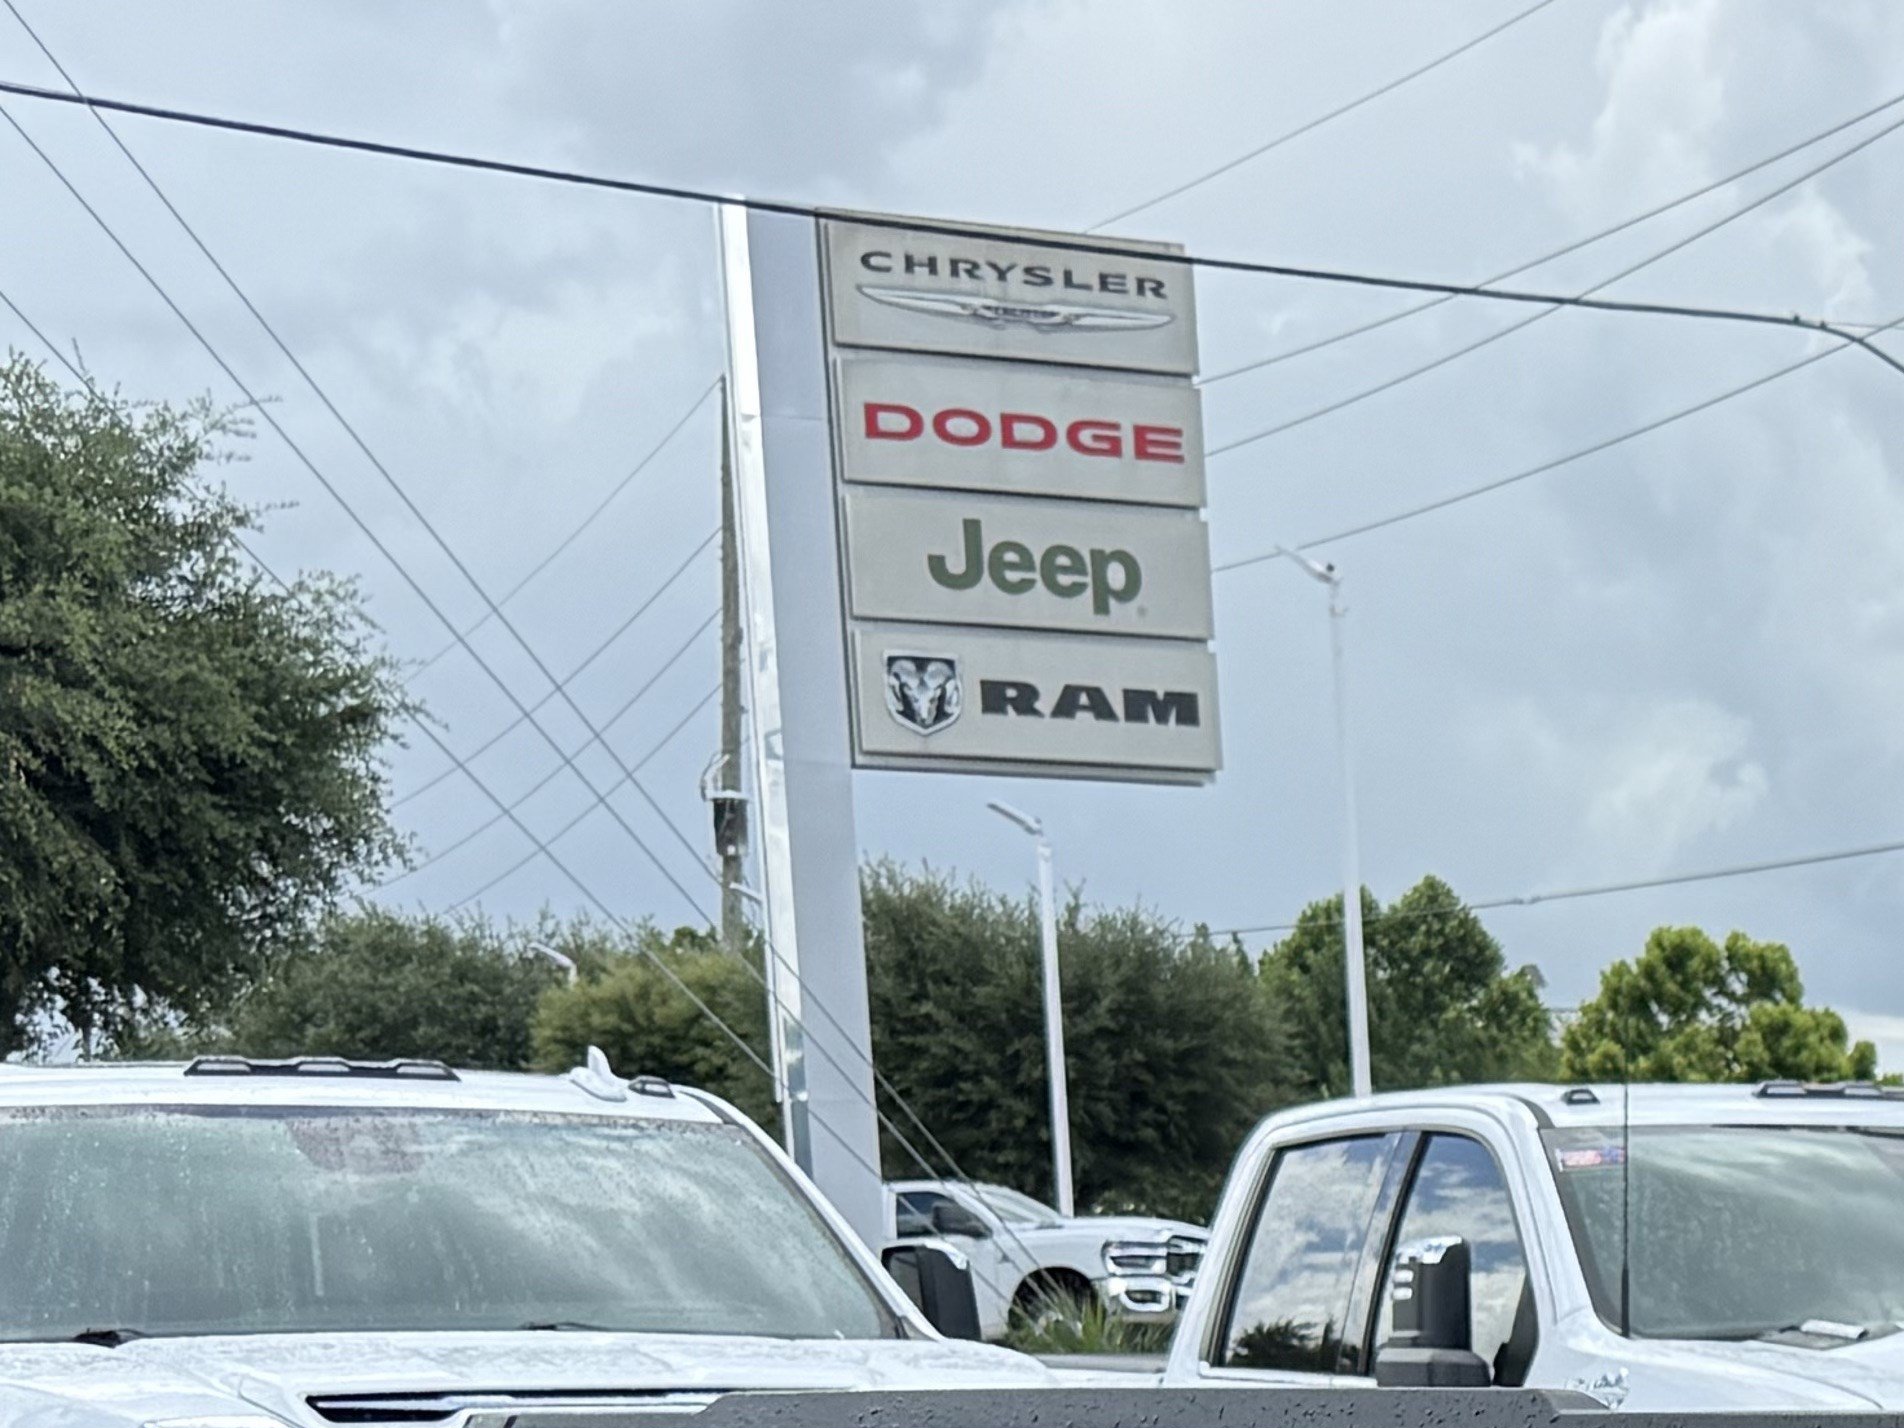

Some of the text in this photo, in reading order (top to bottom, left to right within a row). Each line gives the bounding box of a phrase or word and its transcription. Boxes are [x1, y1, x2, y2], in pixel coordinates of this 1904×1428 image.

[860, 250, 1168, 299] CHRYSLER
[863, 402, 1185, 464] DODGE
[927, 518, 1143, 615] Jeep
[979, 679, 1200, 727] RAM
